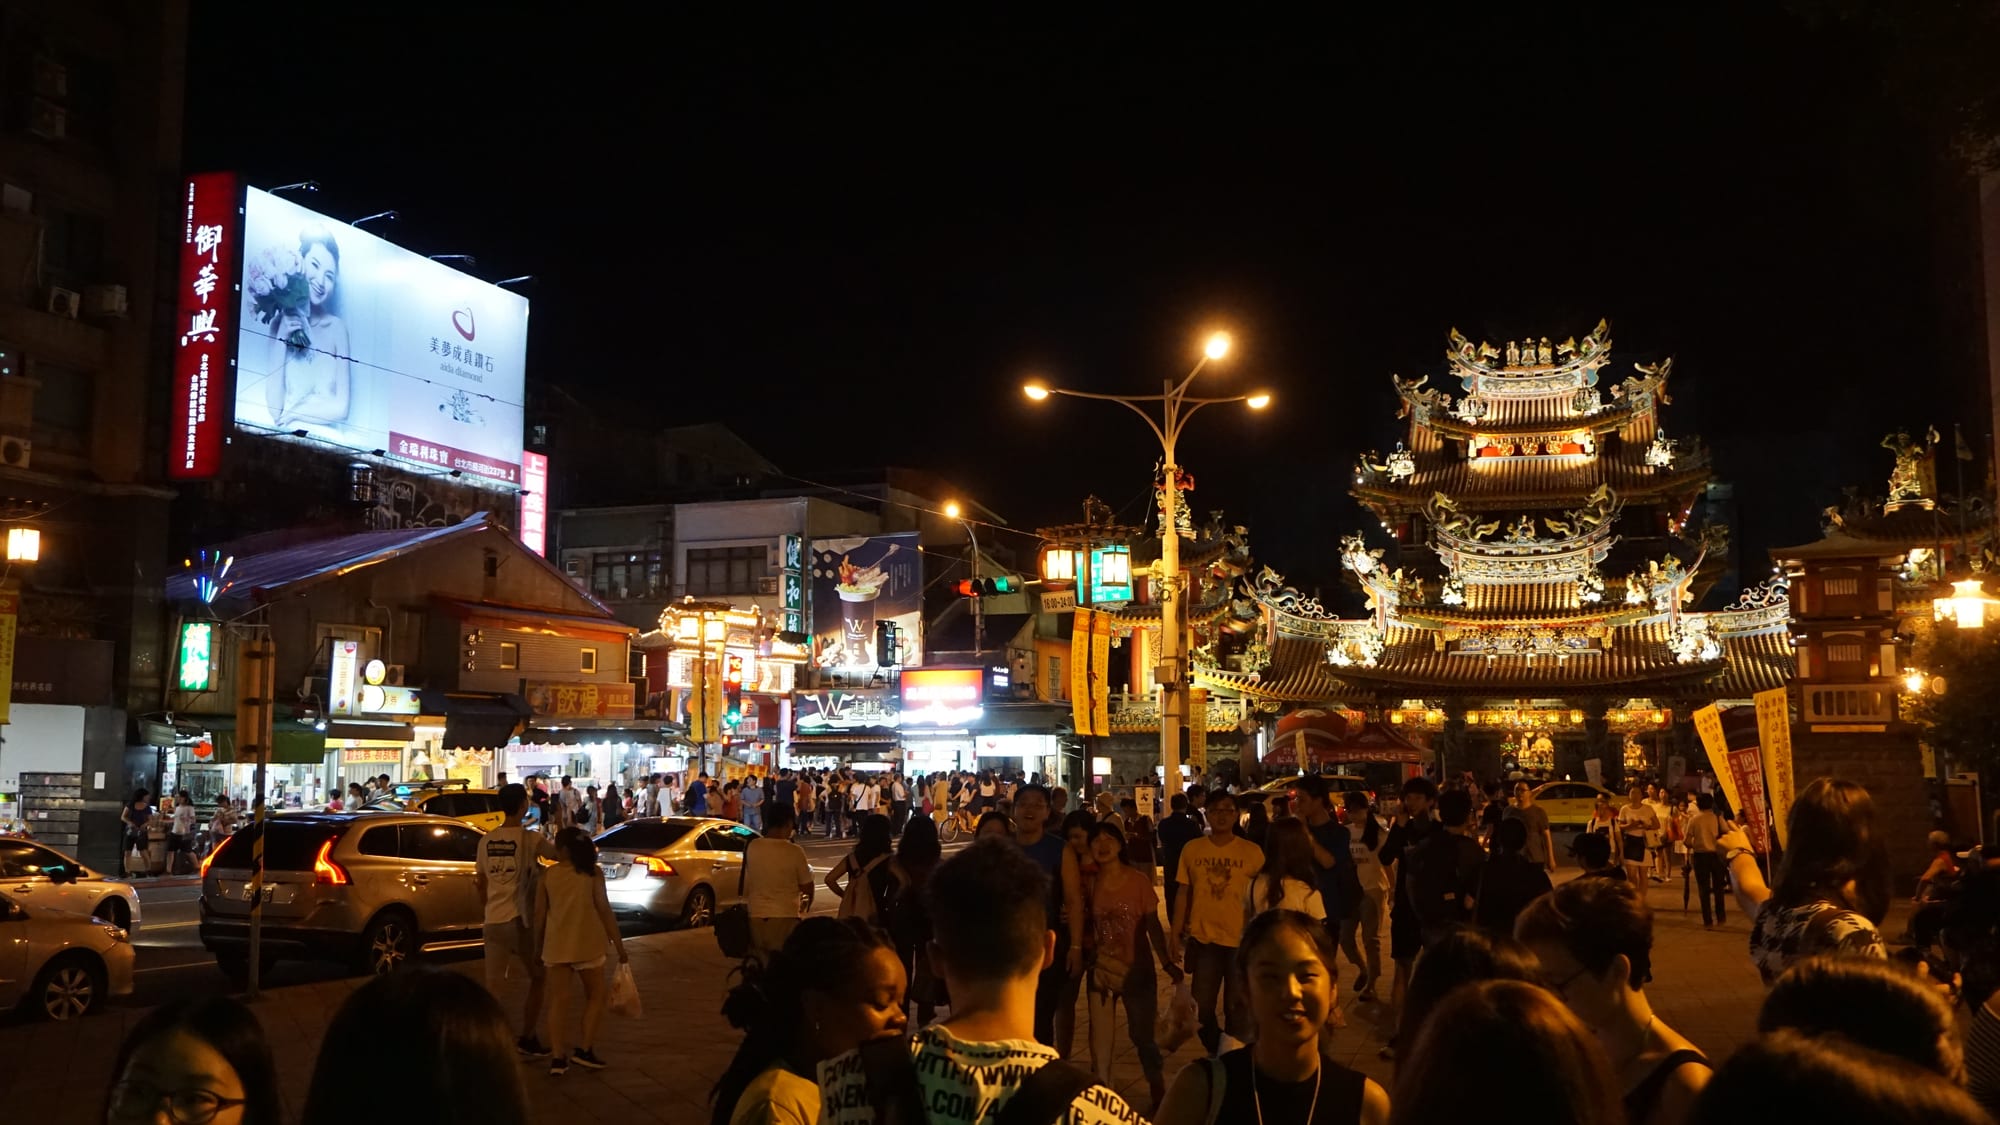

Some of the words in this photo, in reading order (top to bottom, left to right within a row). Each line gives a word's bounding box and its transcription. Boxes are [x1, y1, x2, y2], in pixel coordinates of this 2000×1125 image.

[187, 225, 223, 342] 御華興
[430, 336, 495, 373] 美夢成真鑽石
